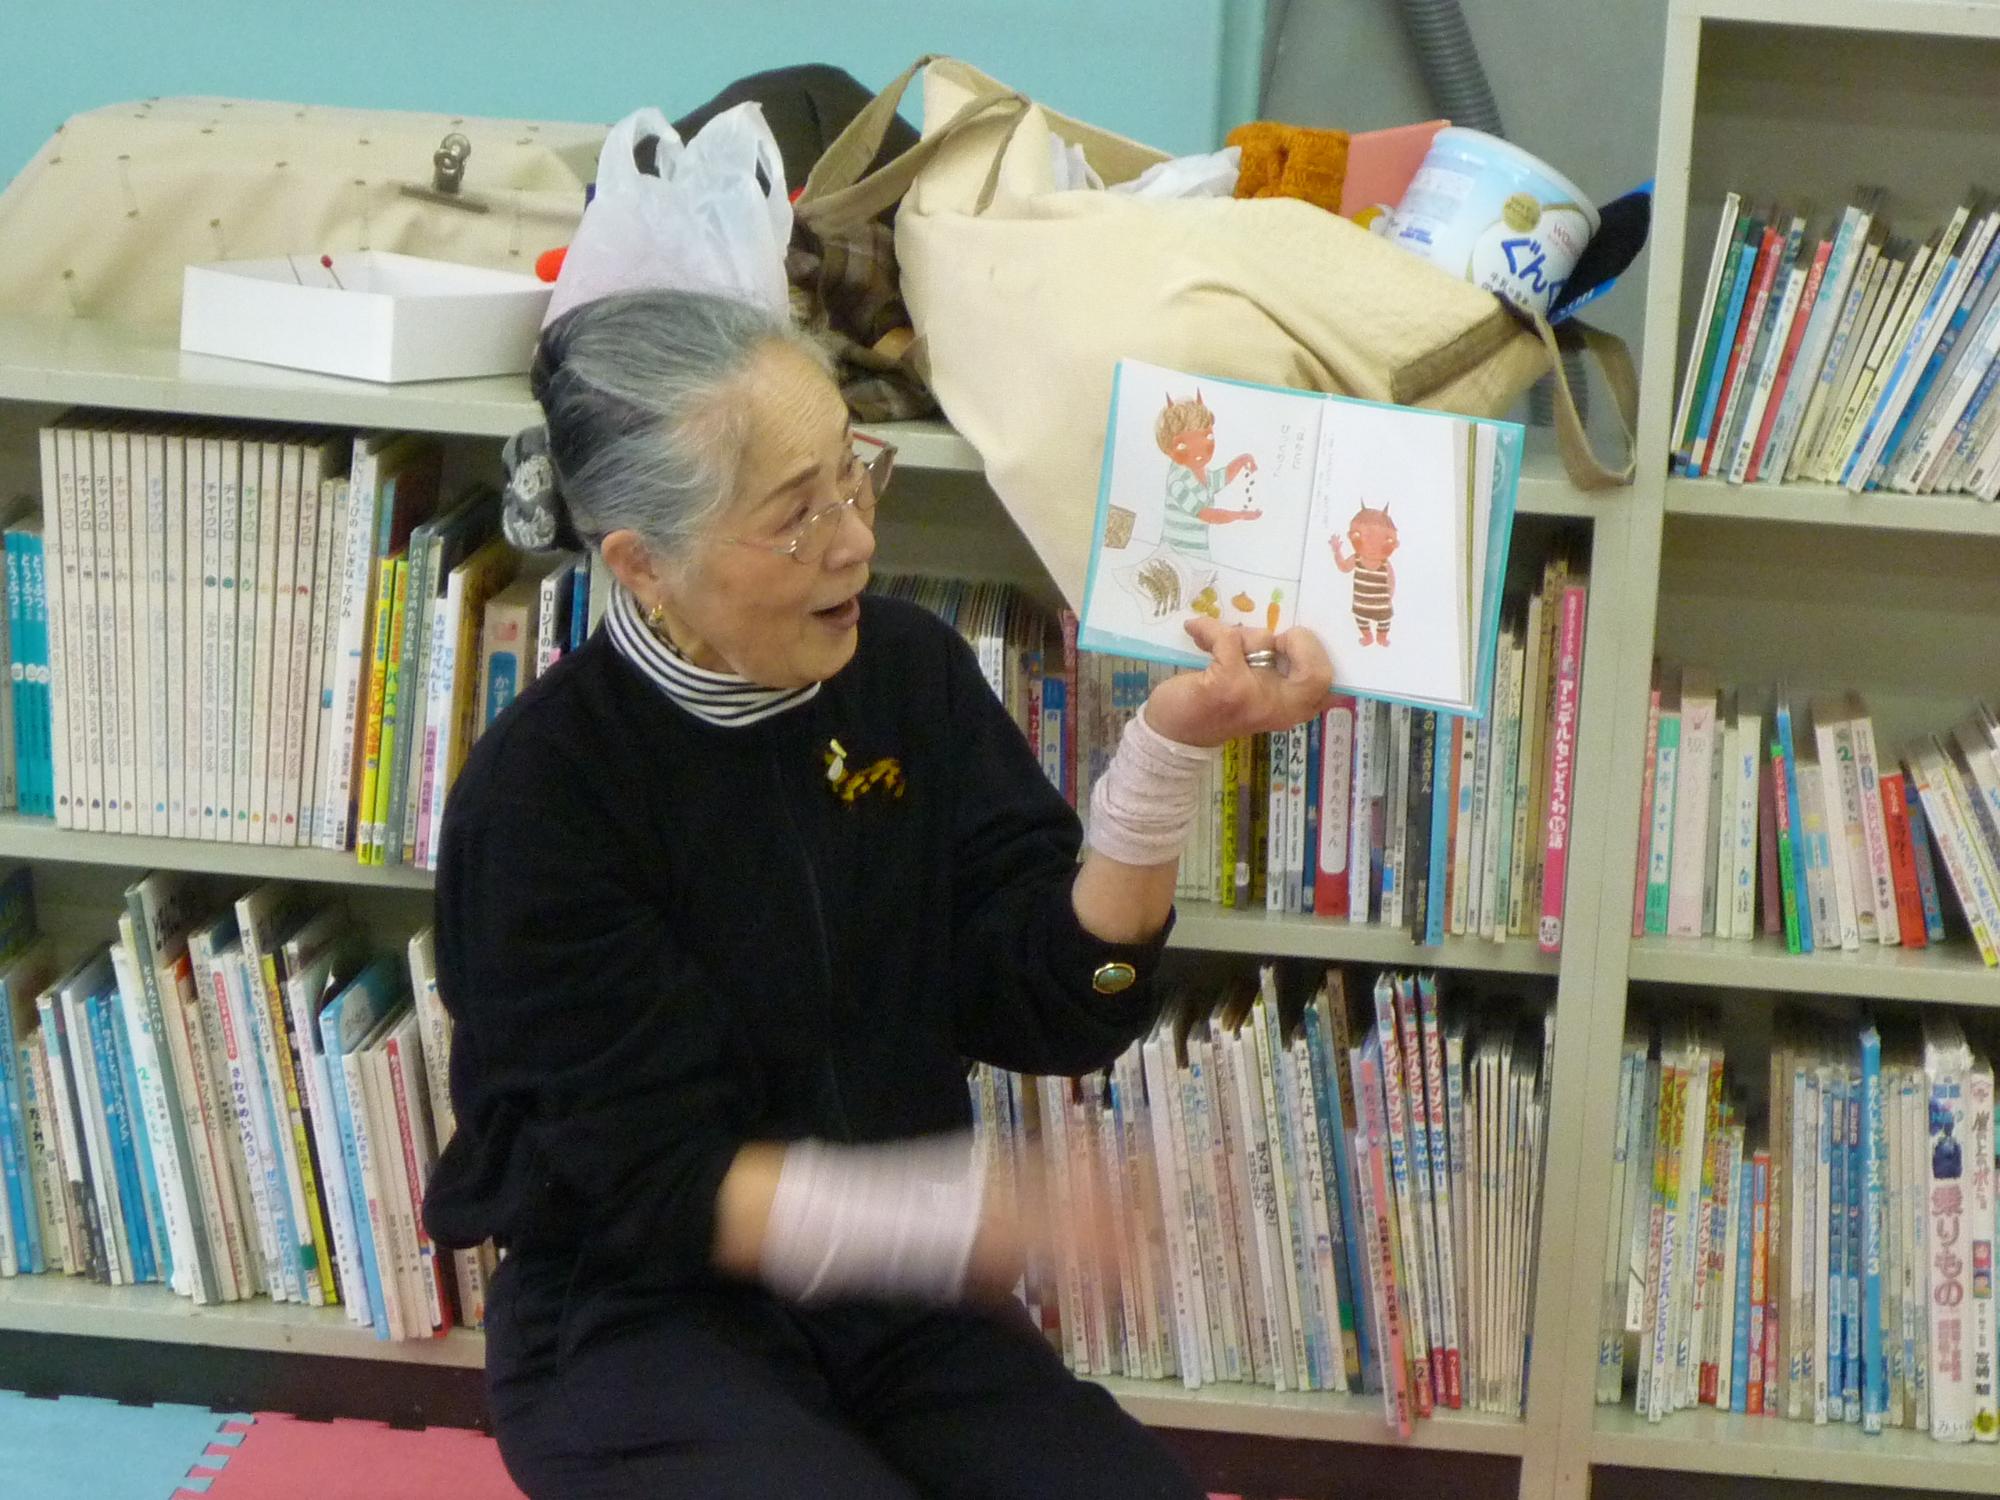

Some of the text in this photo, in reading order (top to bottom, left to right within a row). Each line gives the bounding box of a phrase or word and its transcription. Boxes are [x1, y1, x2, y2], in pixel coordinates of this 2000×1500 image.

[77, 474, 92, 532] チャイクロ
[95, 475, 110, 532] チャイクロ
[205, 482, 217, 540] チャイクロ
[222, 484, 235, 541] チャイクロ
[243, 486, 256, 543] チャイクロ
[300, 490, 314, 547] チャイクロ
[7, 553, 18, 605] どうぶつ
[21, 553, 32, 606] どうぶつ
[32, 554, 43, 607] どうぶつ
[431, 613, 446, 702] おばけでんしゃ
[1328, 734, 1345, 848] あかずきんちゃん
